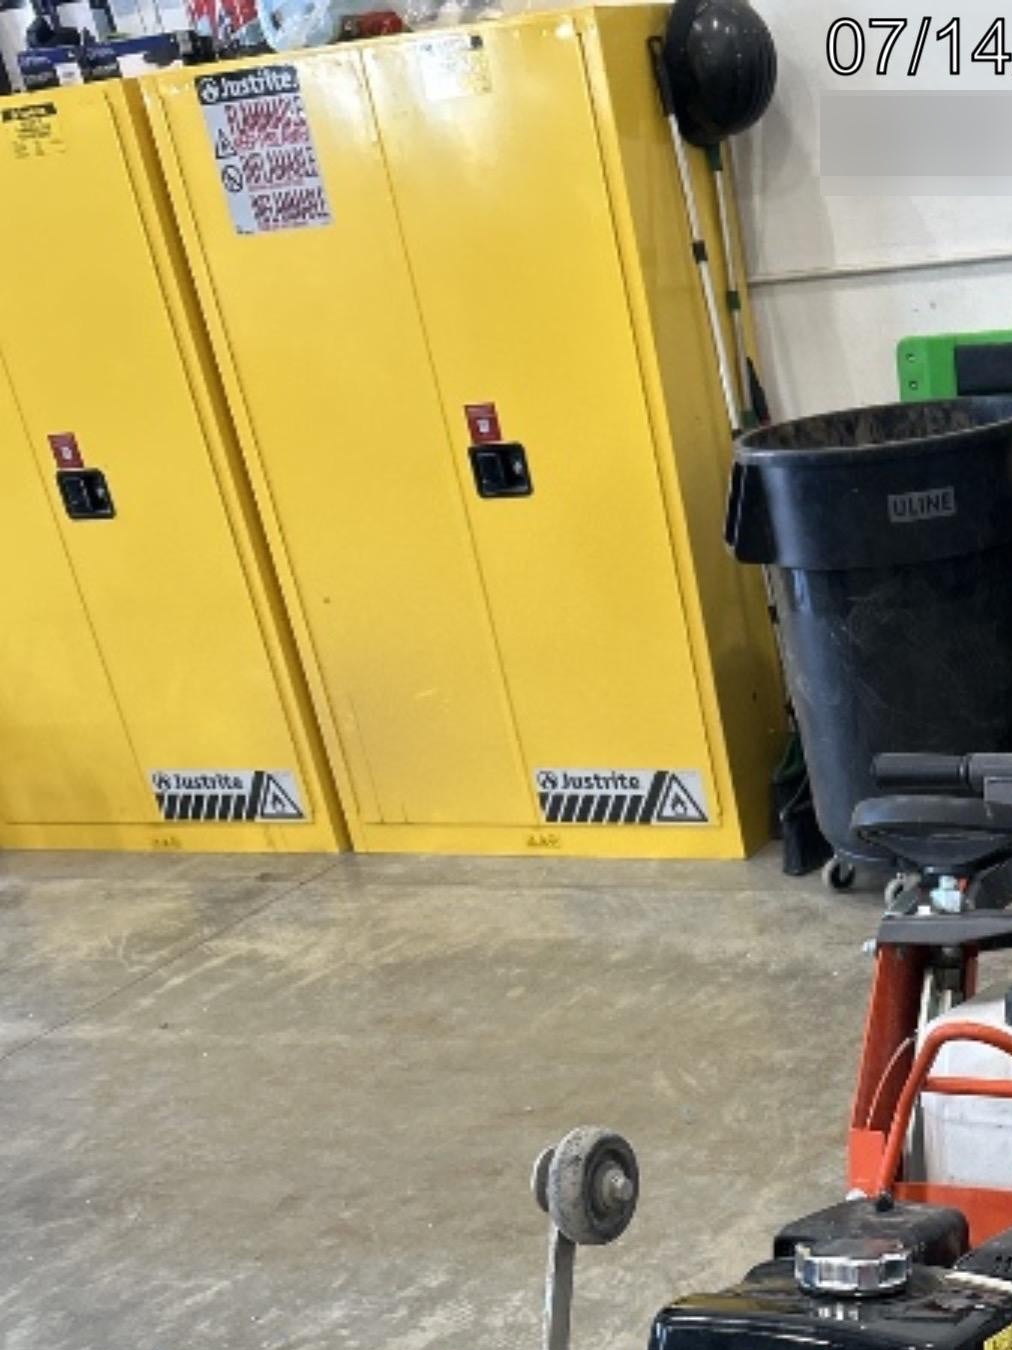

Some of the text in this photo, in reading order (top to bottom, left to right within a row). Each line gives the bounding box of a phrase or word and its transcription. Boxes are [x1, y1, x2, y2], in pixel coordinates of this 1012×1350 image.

[221, 67, 294, 97] Justrite
[892, 491, 955, 518] ULINE
[561, 771, 641, 790] Justrite
